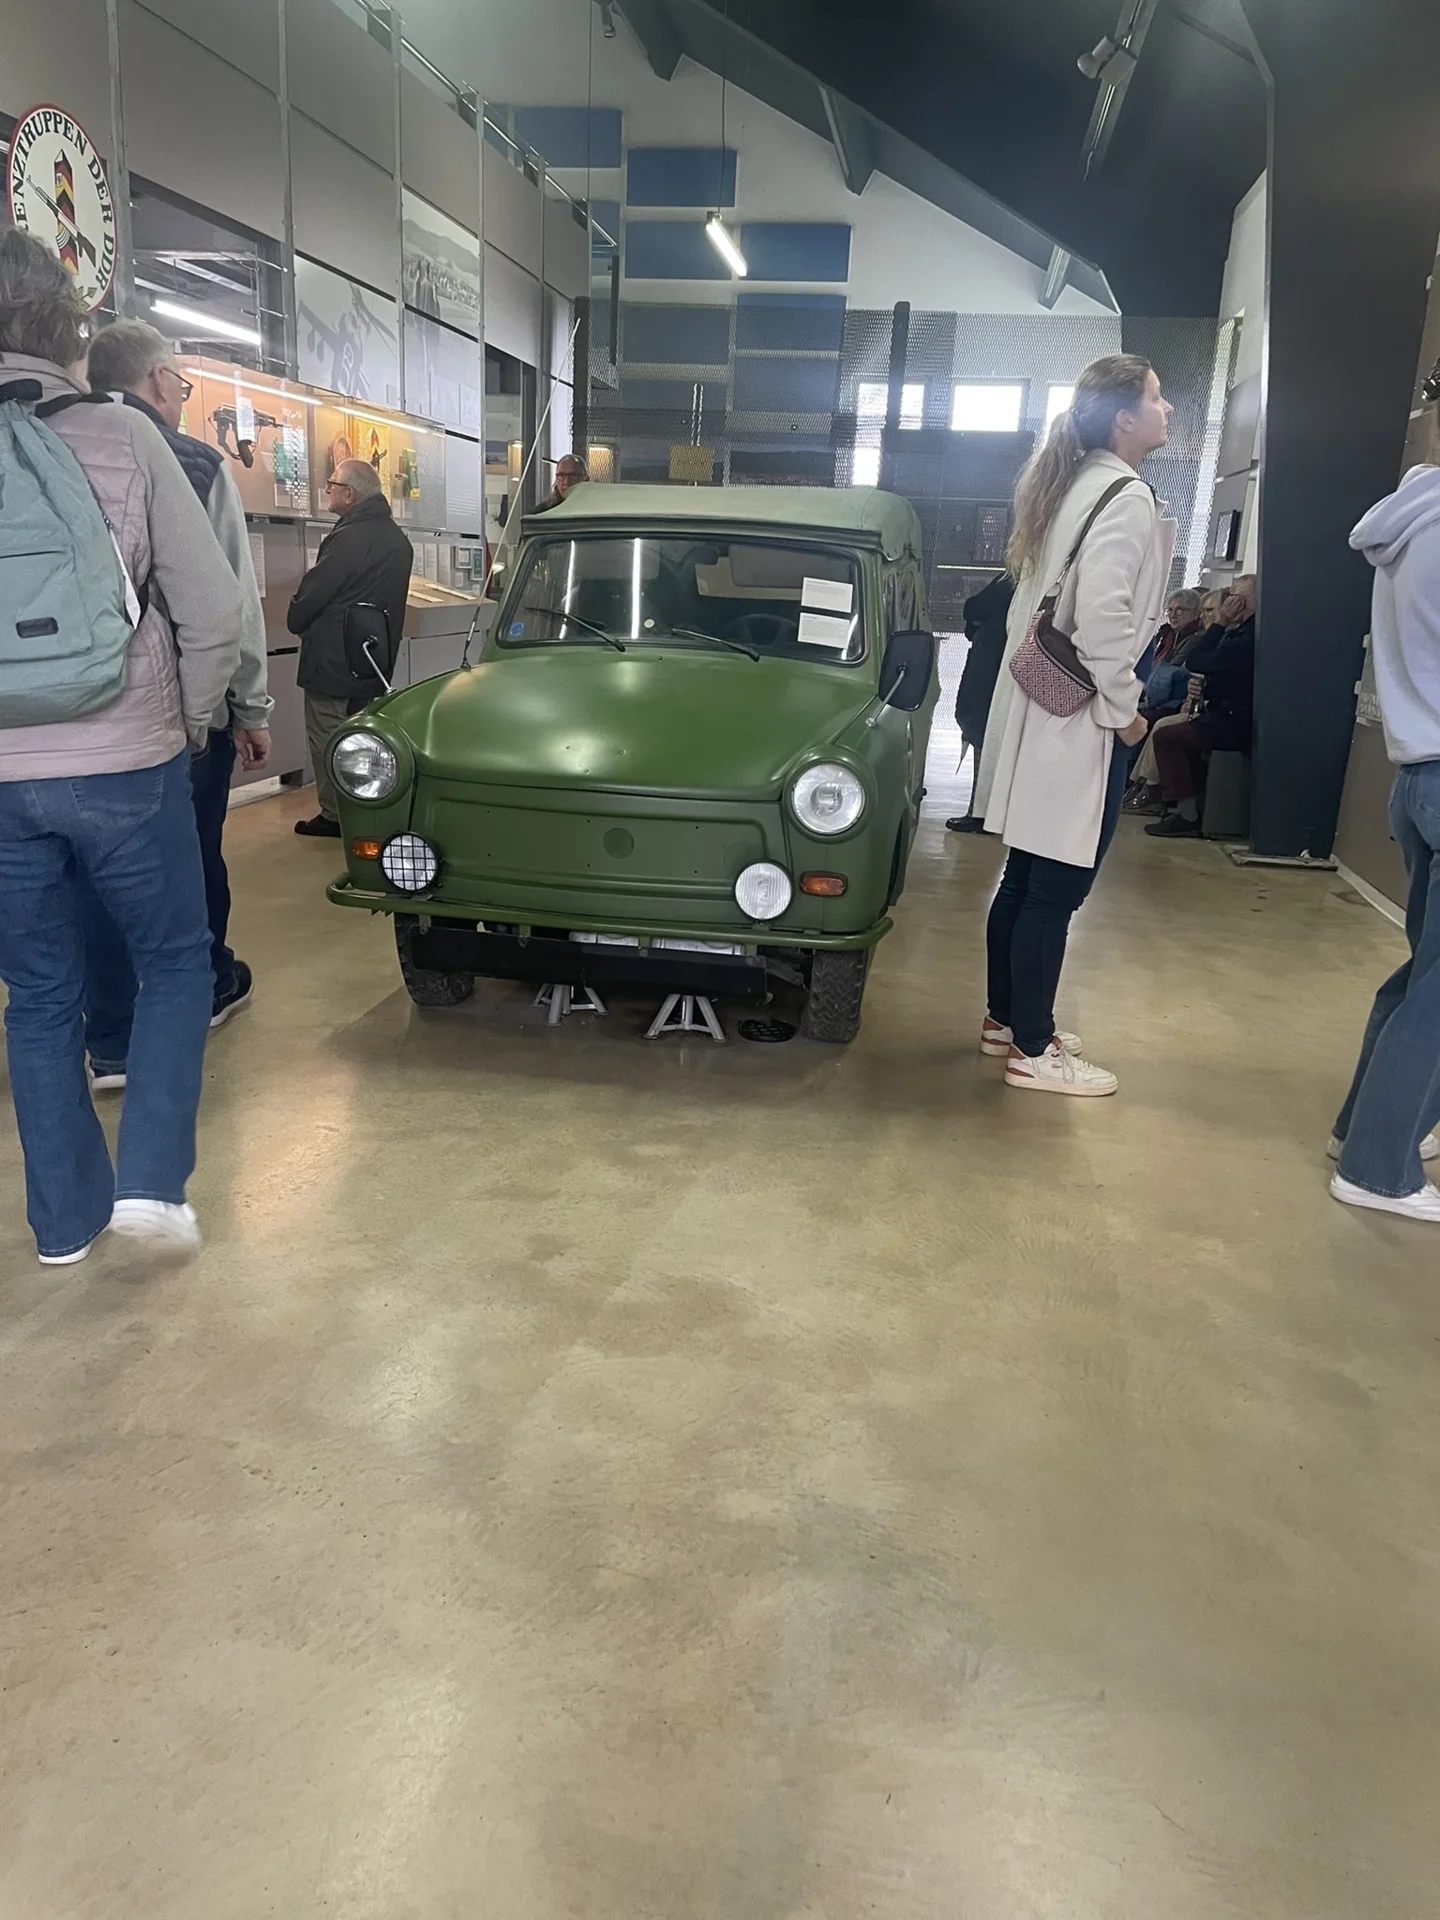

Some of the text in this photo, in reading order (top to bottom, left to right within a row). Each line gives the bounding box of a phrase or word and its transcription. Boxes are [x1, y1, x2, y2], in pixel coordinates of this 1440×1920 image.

[13, 111, 114, 291] ENZTRUPPEN DER DDR
